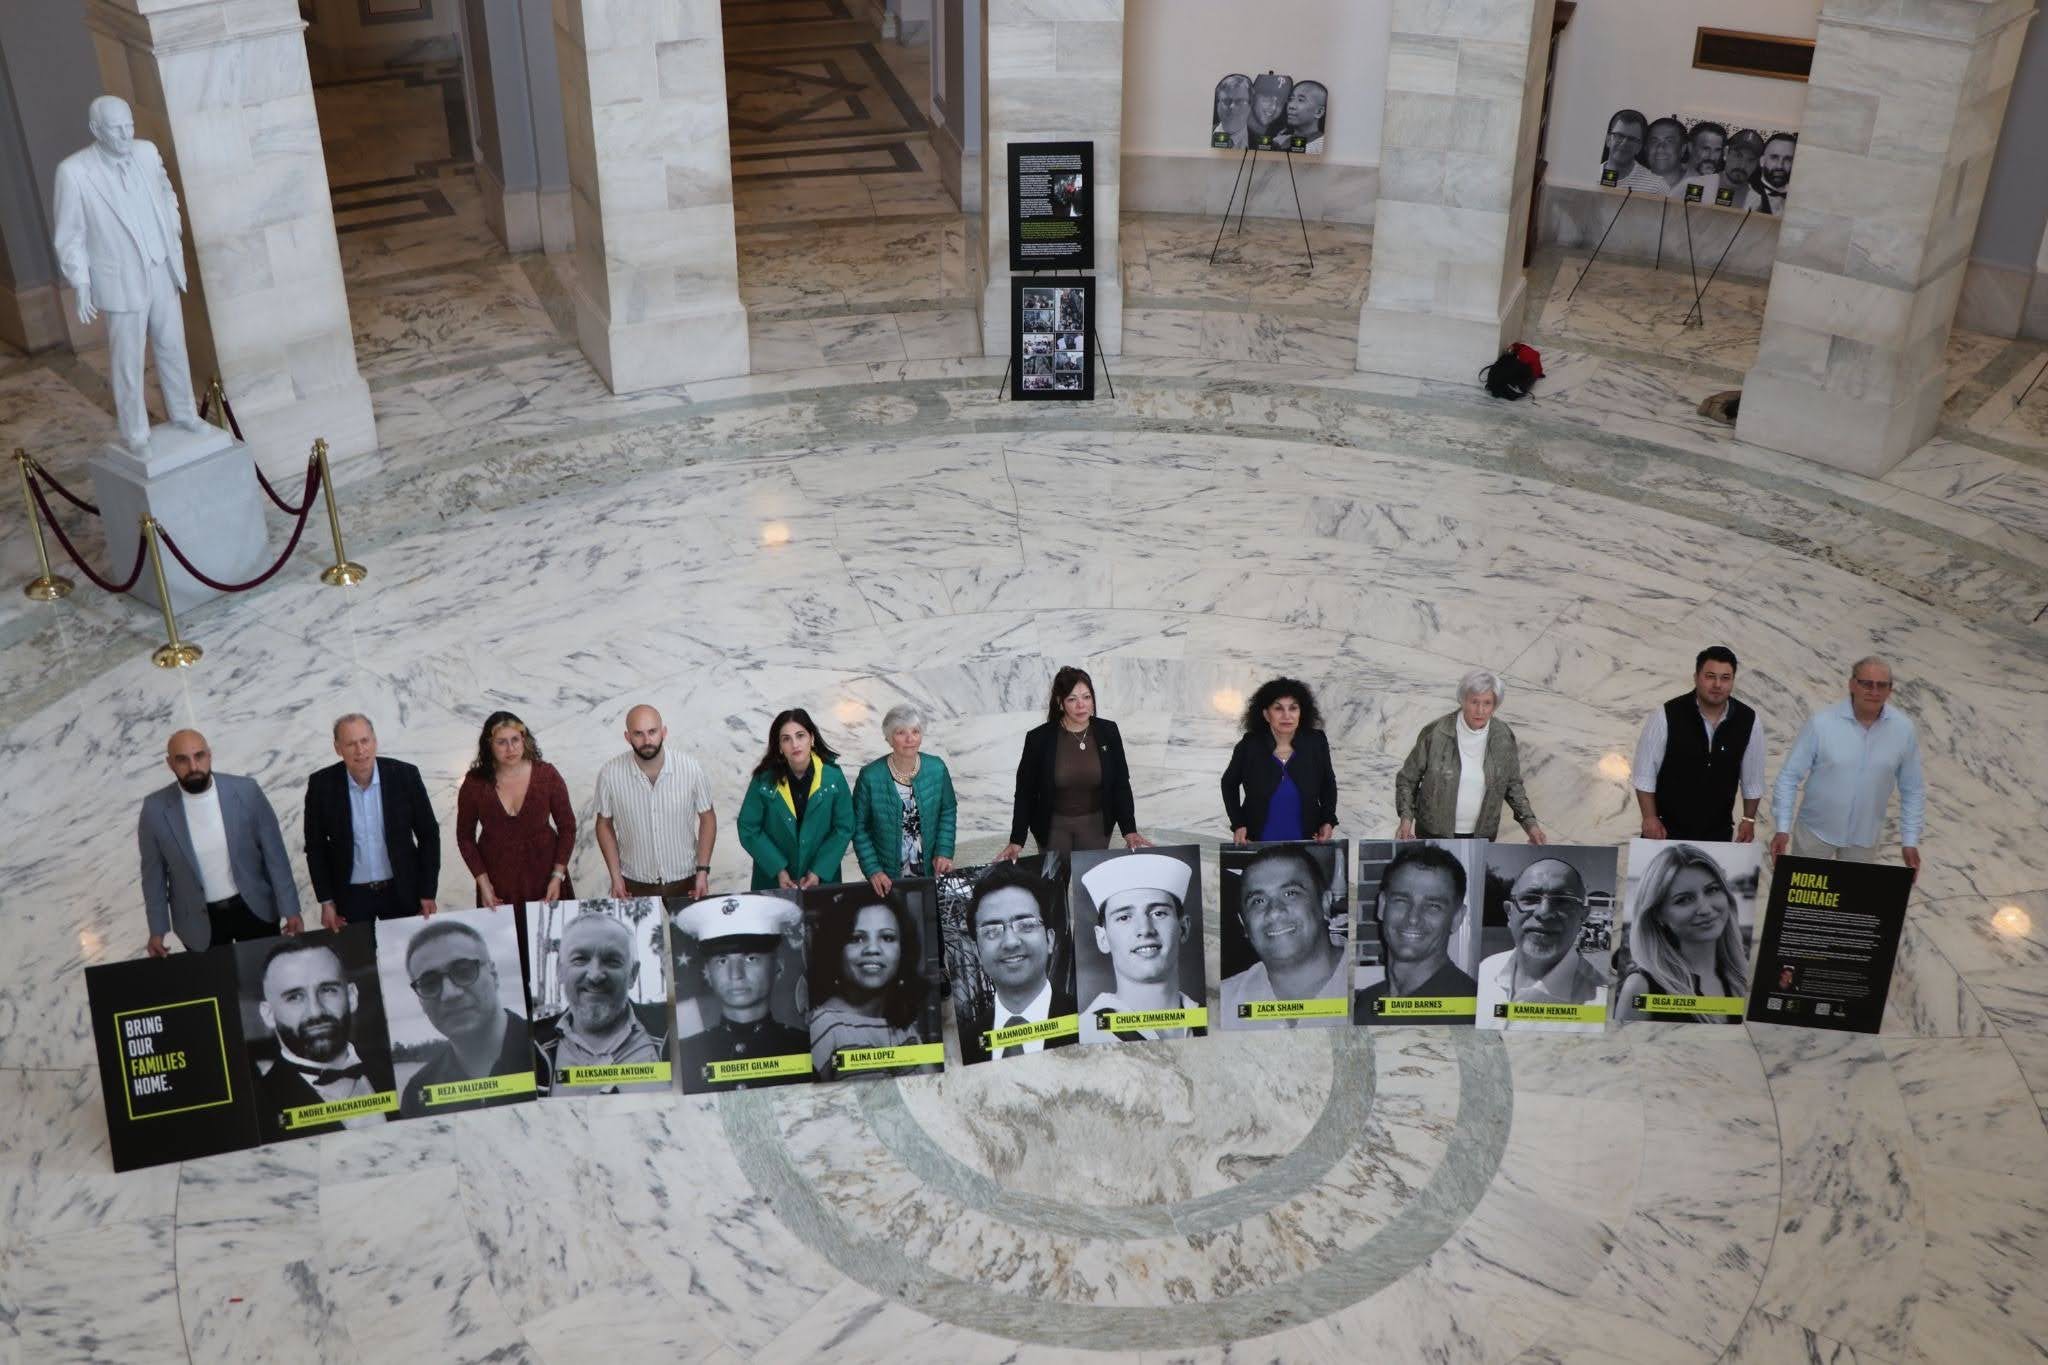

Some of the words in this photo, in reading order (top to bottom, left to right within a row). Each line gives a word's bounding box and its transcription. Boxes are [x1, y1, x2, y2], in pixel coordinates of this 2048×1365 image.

[1791, 872, 1829, 890] MORAL
[1787, 889, 1840, 908] COURAGE
[1257, 1004, 1276, 1013] ZACK
[1277, 1003, 1304, 1012] SHAHIN
[1391, 1000, 1413, 1009] DAVID
[1414, 1000, 1443, 1009] BARNES
[1652, 997, 1671, 1006] OLGA
[1514, 1006, 1545, 1015] KAMRAN
[1546, 1007, 1578, 1016] HEKMATI
[1116, 1015, 1141, 1024] CHUCK
[1142, 1012, 1186, 1023] ZIMMERMAN
[125, 1015, 163, 1038] BRING
[996, 1026, 1033, 1041] MAHMOOD
[1034, 1021, 1059, 1033] HABIBI
[128, 1037, 154, 1057] OUR
[850, 1052, 872, 1062] ALINA
[873, 1050, 895, 1060] LOPEZ
[131, 1051, 187, 1077] FAMILIES
[720, 1062, 750, 1073] ROBERT
[751, 1060, 780, 1071] GILMAN
[576, 1067, 619, 1078] ALEKSANDR
[620, 1066, 655, 1076] ANTONOV
[134, 1074, 173, 1096] HOME.
[437, 1085, 457, 1096] REZA
[458, 1080, 499, 1093] VALIZADEH
[298, 1107, 324, 1119] ANDRE
